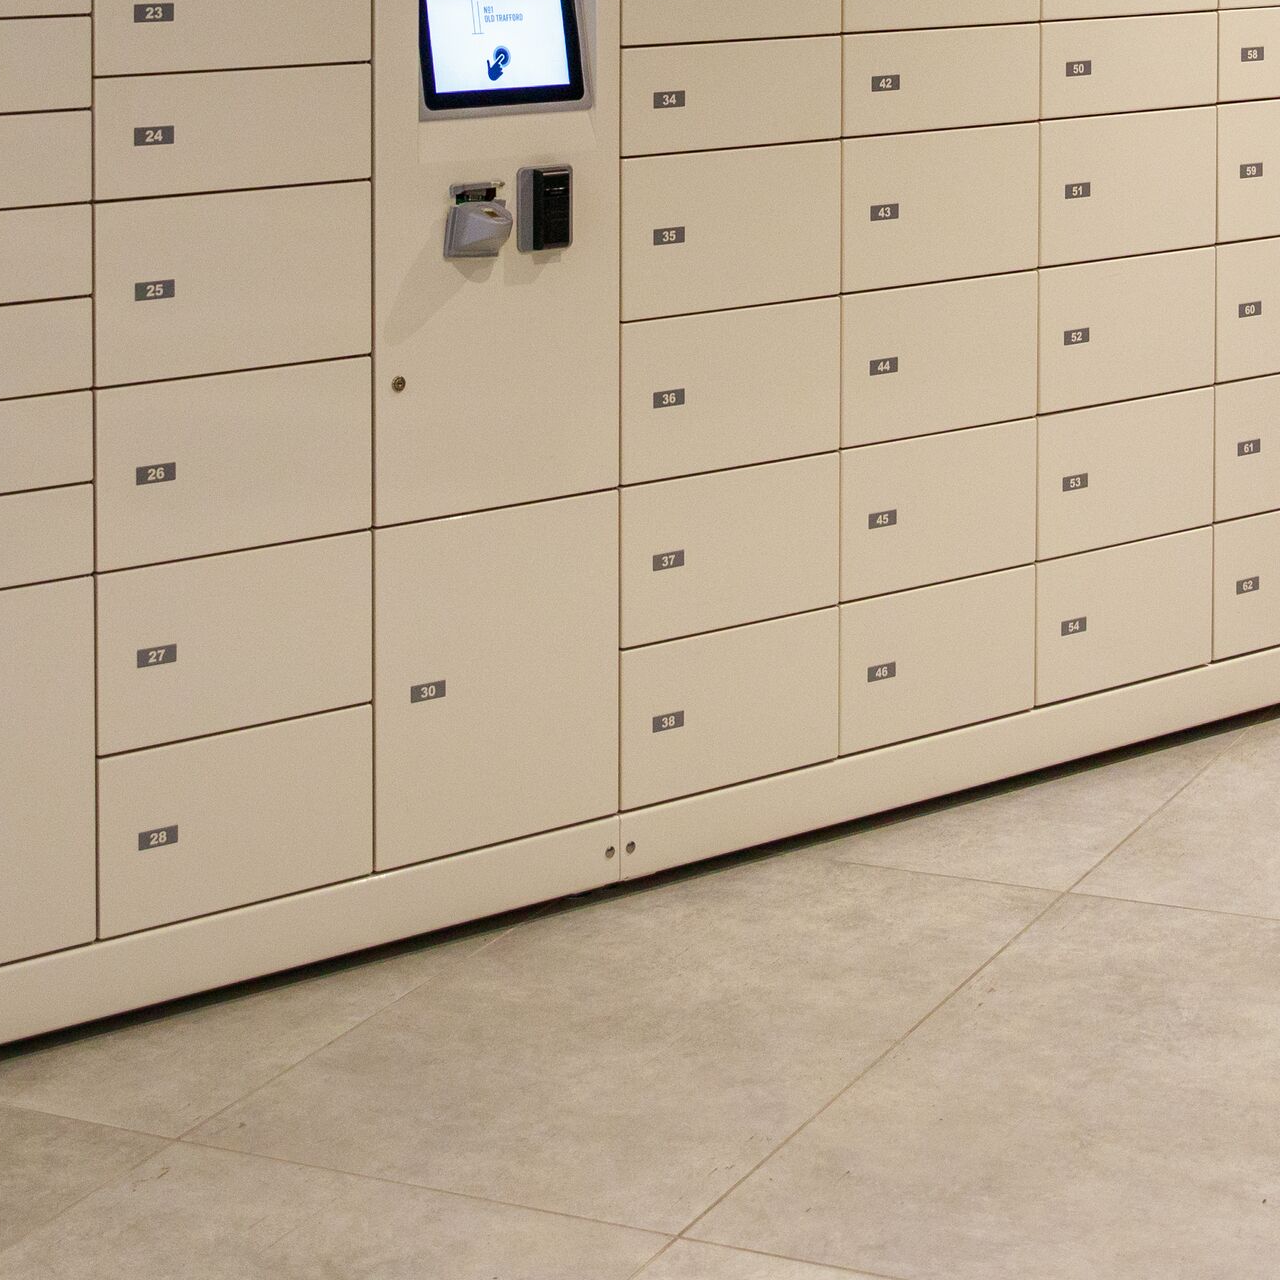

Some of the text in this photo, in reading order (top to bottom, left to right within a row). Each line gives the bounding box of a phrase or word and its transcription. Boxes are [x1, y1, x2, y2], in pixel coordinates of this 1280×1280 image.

[145, 6, 163, 19] 23
[484, 13, 524, 22] OLD TRAFFORD
[1247, 49, 1258, 59] 58
[1073, 63, 1084, 74] 50
[879, 78, 892, 89] 42
[662, 94, 677, 106] 34
[145, 129, 163, 142] 24
[1246, 166, 1257, 176] 59
[1072, 185, 1082, 196] 51
[878, 207, 891, 218] 43
[662, 230, 676, 242] 35
[146, 284, 164, 297] 25
[1244, 304, 1256, 315] 60
[1071, 331, 1082, 342] 52
[877, 360, 890, 372] 44
[662, 392, 676, 405] 36
[1244, 442, 1253, 453] 61
[147, 467, 165, 481] 26
[1070, 477, 1081, 488] 53
[876, 513, 889, 525] 45
[662, 554, 676, 567] 37
[1242, 580, 1253, 591] 62
[1068, 621, 1080, 632] 54
[148, 649, 166, 663] 27
[875, 666, 888, 678] 46
[421, 685, 436, 698] 30
[662, 715, 675, 728] 38
[150, 831, 167, 845] 28
